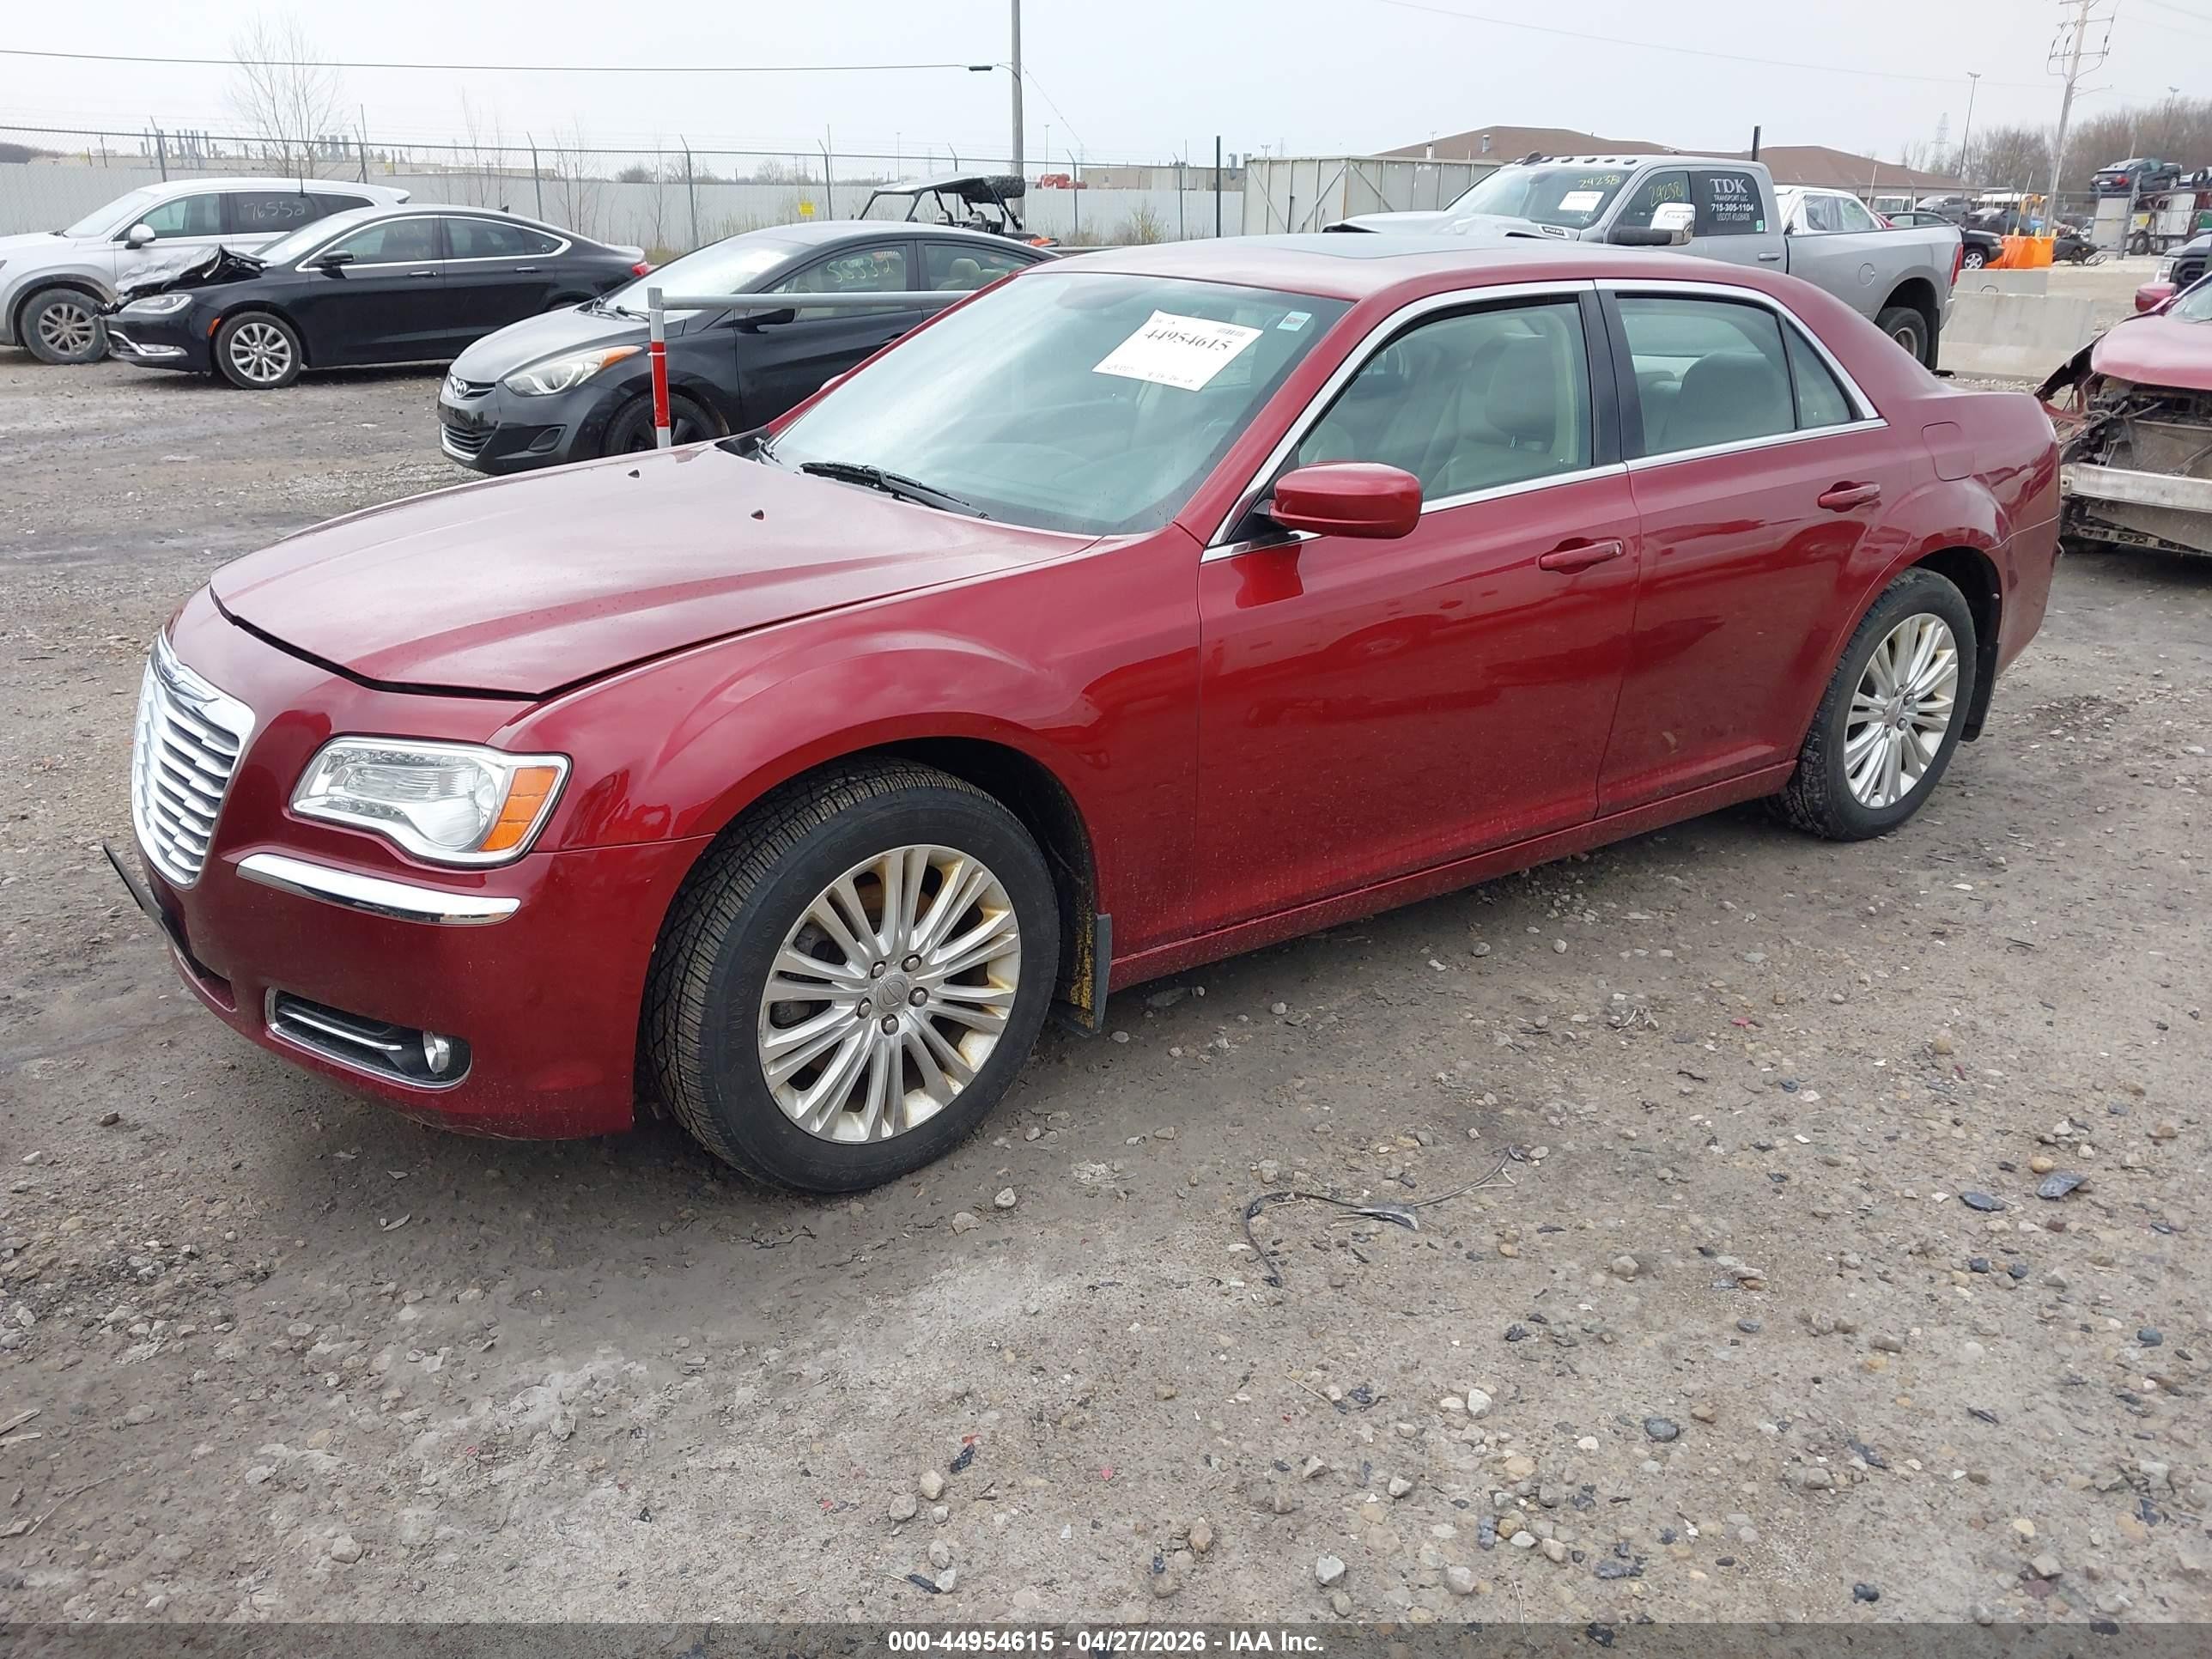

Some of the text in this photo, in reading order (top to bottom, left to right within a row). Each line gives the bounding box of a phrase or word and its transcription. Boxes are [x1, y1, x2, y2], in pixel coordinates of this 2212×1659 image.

[1578, 173, 1620, 189] 29238
[1710, 178, 1748, 194] TDK
[1648, 180, 1684, 208] 29238
[244, 200, 306, 221] 76552
[1144, 328, 1233, 351] 44954615
